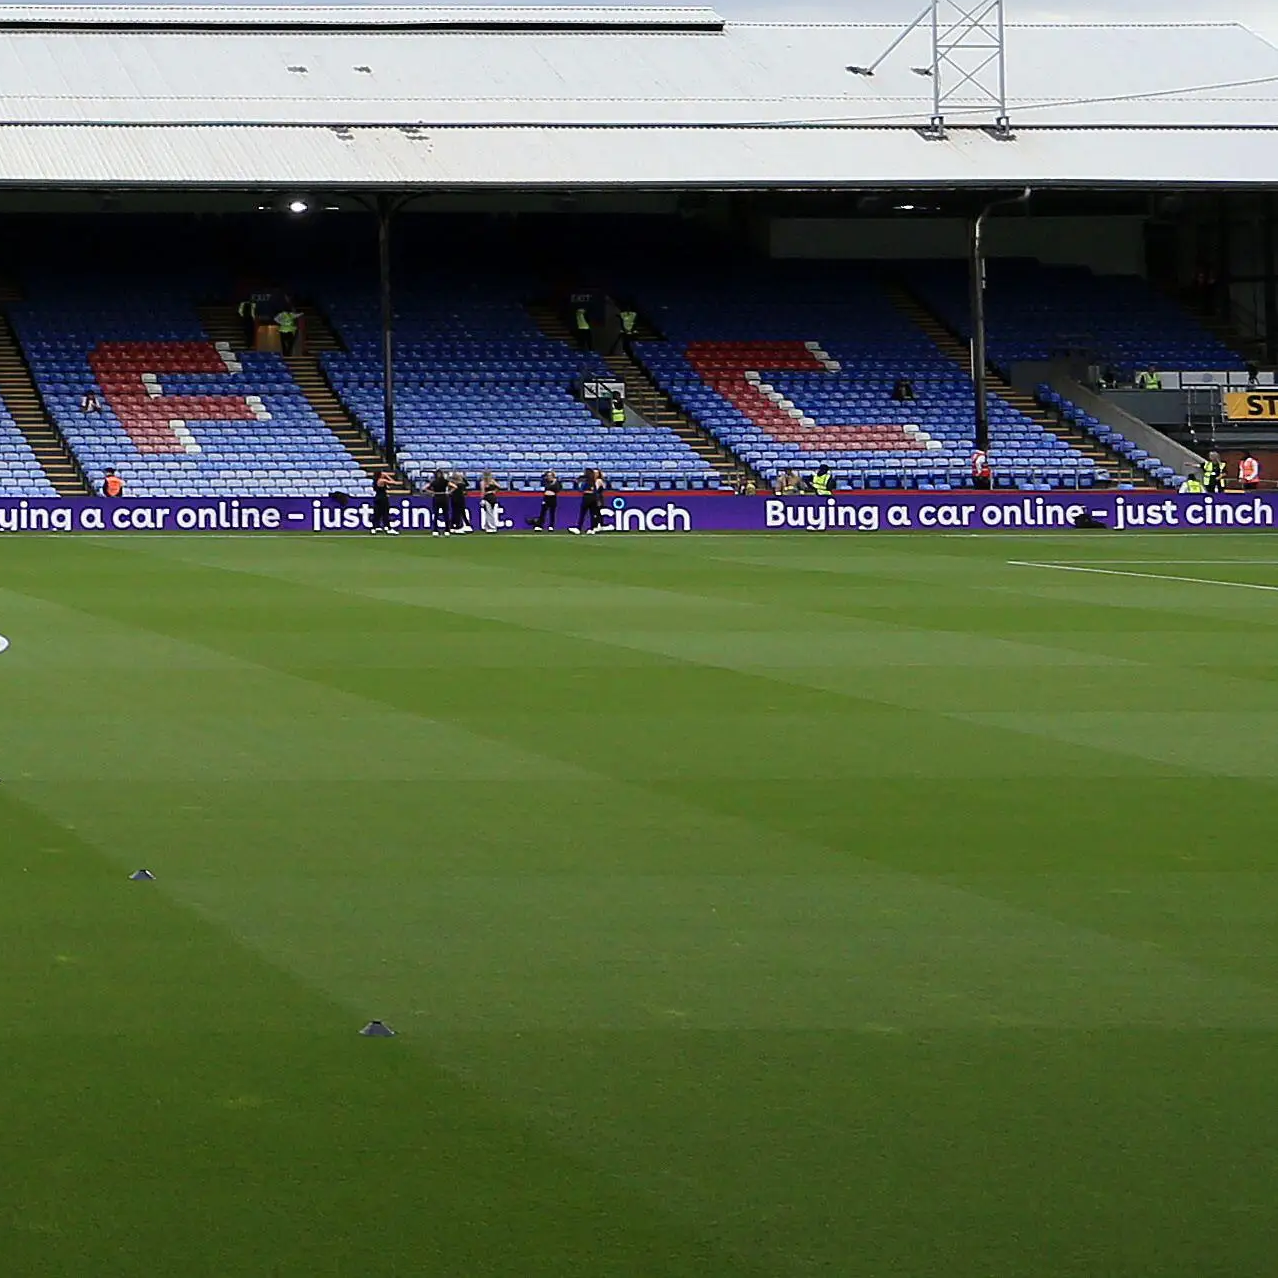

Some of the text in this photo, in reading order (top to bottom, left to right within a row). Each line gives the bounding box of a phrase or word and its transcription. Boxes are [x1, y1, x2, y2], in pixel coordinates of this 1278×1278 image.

[1246, 395, 1278, 416] ST
[81, 508, 106, 529] a
[113, 508, 171, 529] car
[177, 500, 282, 529] online
[312, 500, 374, 531] just
[388, 499, 471, 529] cin
[597, 497, 691, 531] cinch
[766, 498, 880, 530] Buying
[888, 505, 913, 526] a
[919, 505, 977, 526] car
[983, 497, 1087, 526] online
[1113, 497, 1180, 530] just
[1186, 496, 1274, 525] cinch
